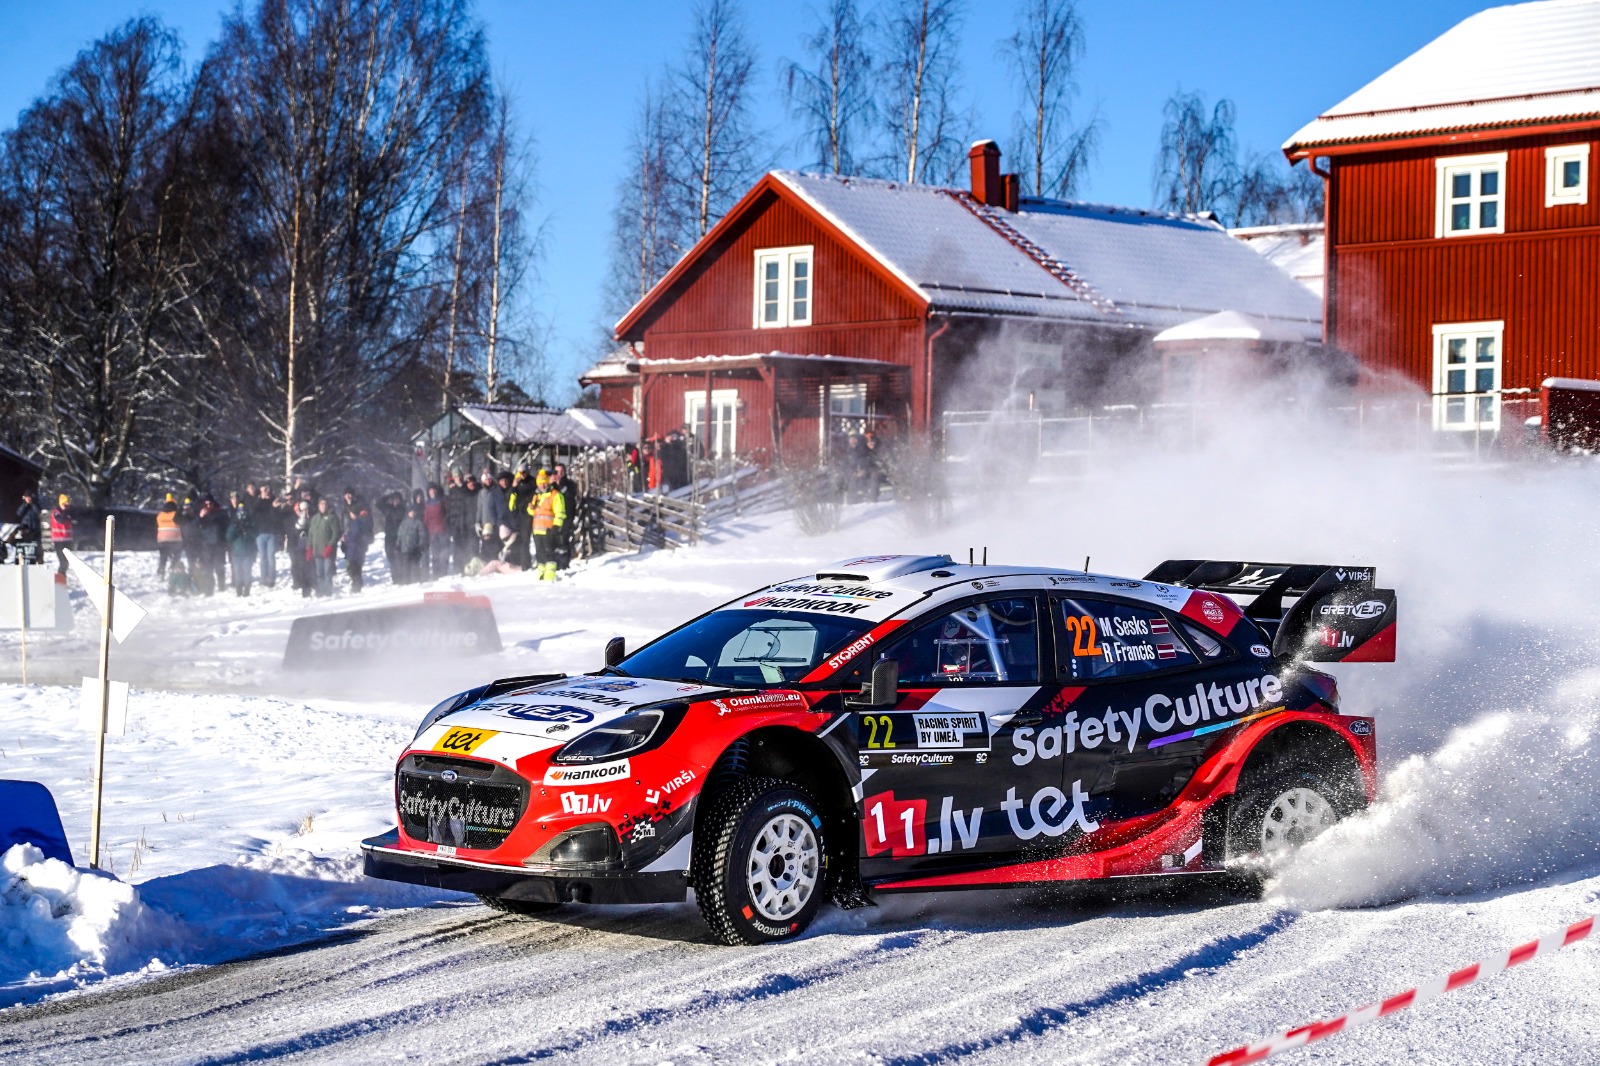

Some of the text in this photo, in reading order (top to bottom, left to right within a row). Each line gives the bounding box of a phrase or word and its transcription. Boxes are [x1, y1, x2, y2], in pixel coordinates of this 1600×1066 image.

[1348, 568, 1371, 581] VIRŠI
[767, 583, 893, 599] SafetyCulture
[309, 629, 479, 651] SafetyCulture
[1066, 615, 1149, 657] 22 M Sesks
[1323, 629, 1355, 648] 11.lv
[828, 633, 875, 669] STORENT
[1102, 640, 1156, 663] R Francis
[863, 715, 977, 749] 22 RACING SPIRIT
[1011, 674, 1283, 766] SafetyCulture
[443, 730, 483, 751] tet
[921, 729, 960, 743] BY UMEÅ.
[891, 754, 954, 765] SafetyCulture
[976, 753, 987, 762] SC
[661, 769, 696, 794] VIRŠI
[400, 789, 516, 827] SafetyCulture
[560, 790, 613, 815] 11.lv
[1000, 779, 1100, 840] tet
[870, 796, 984, 854] 11.lv
